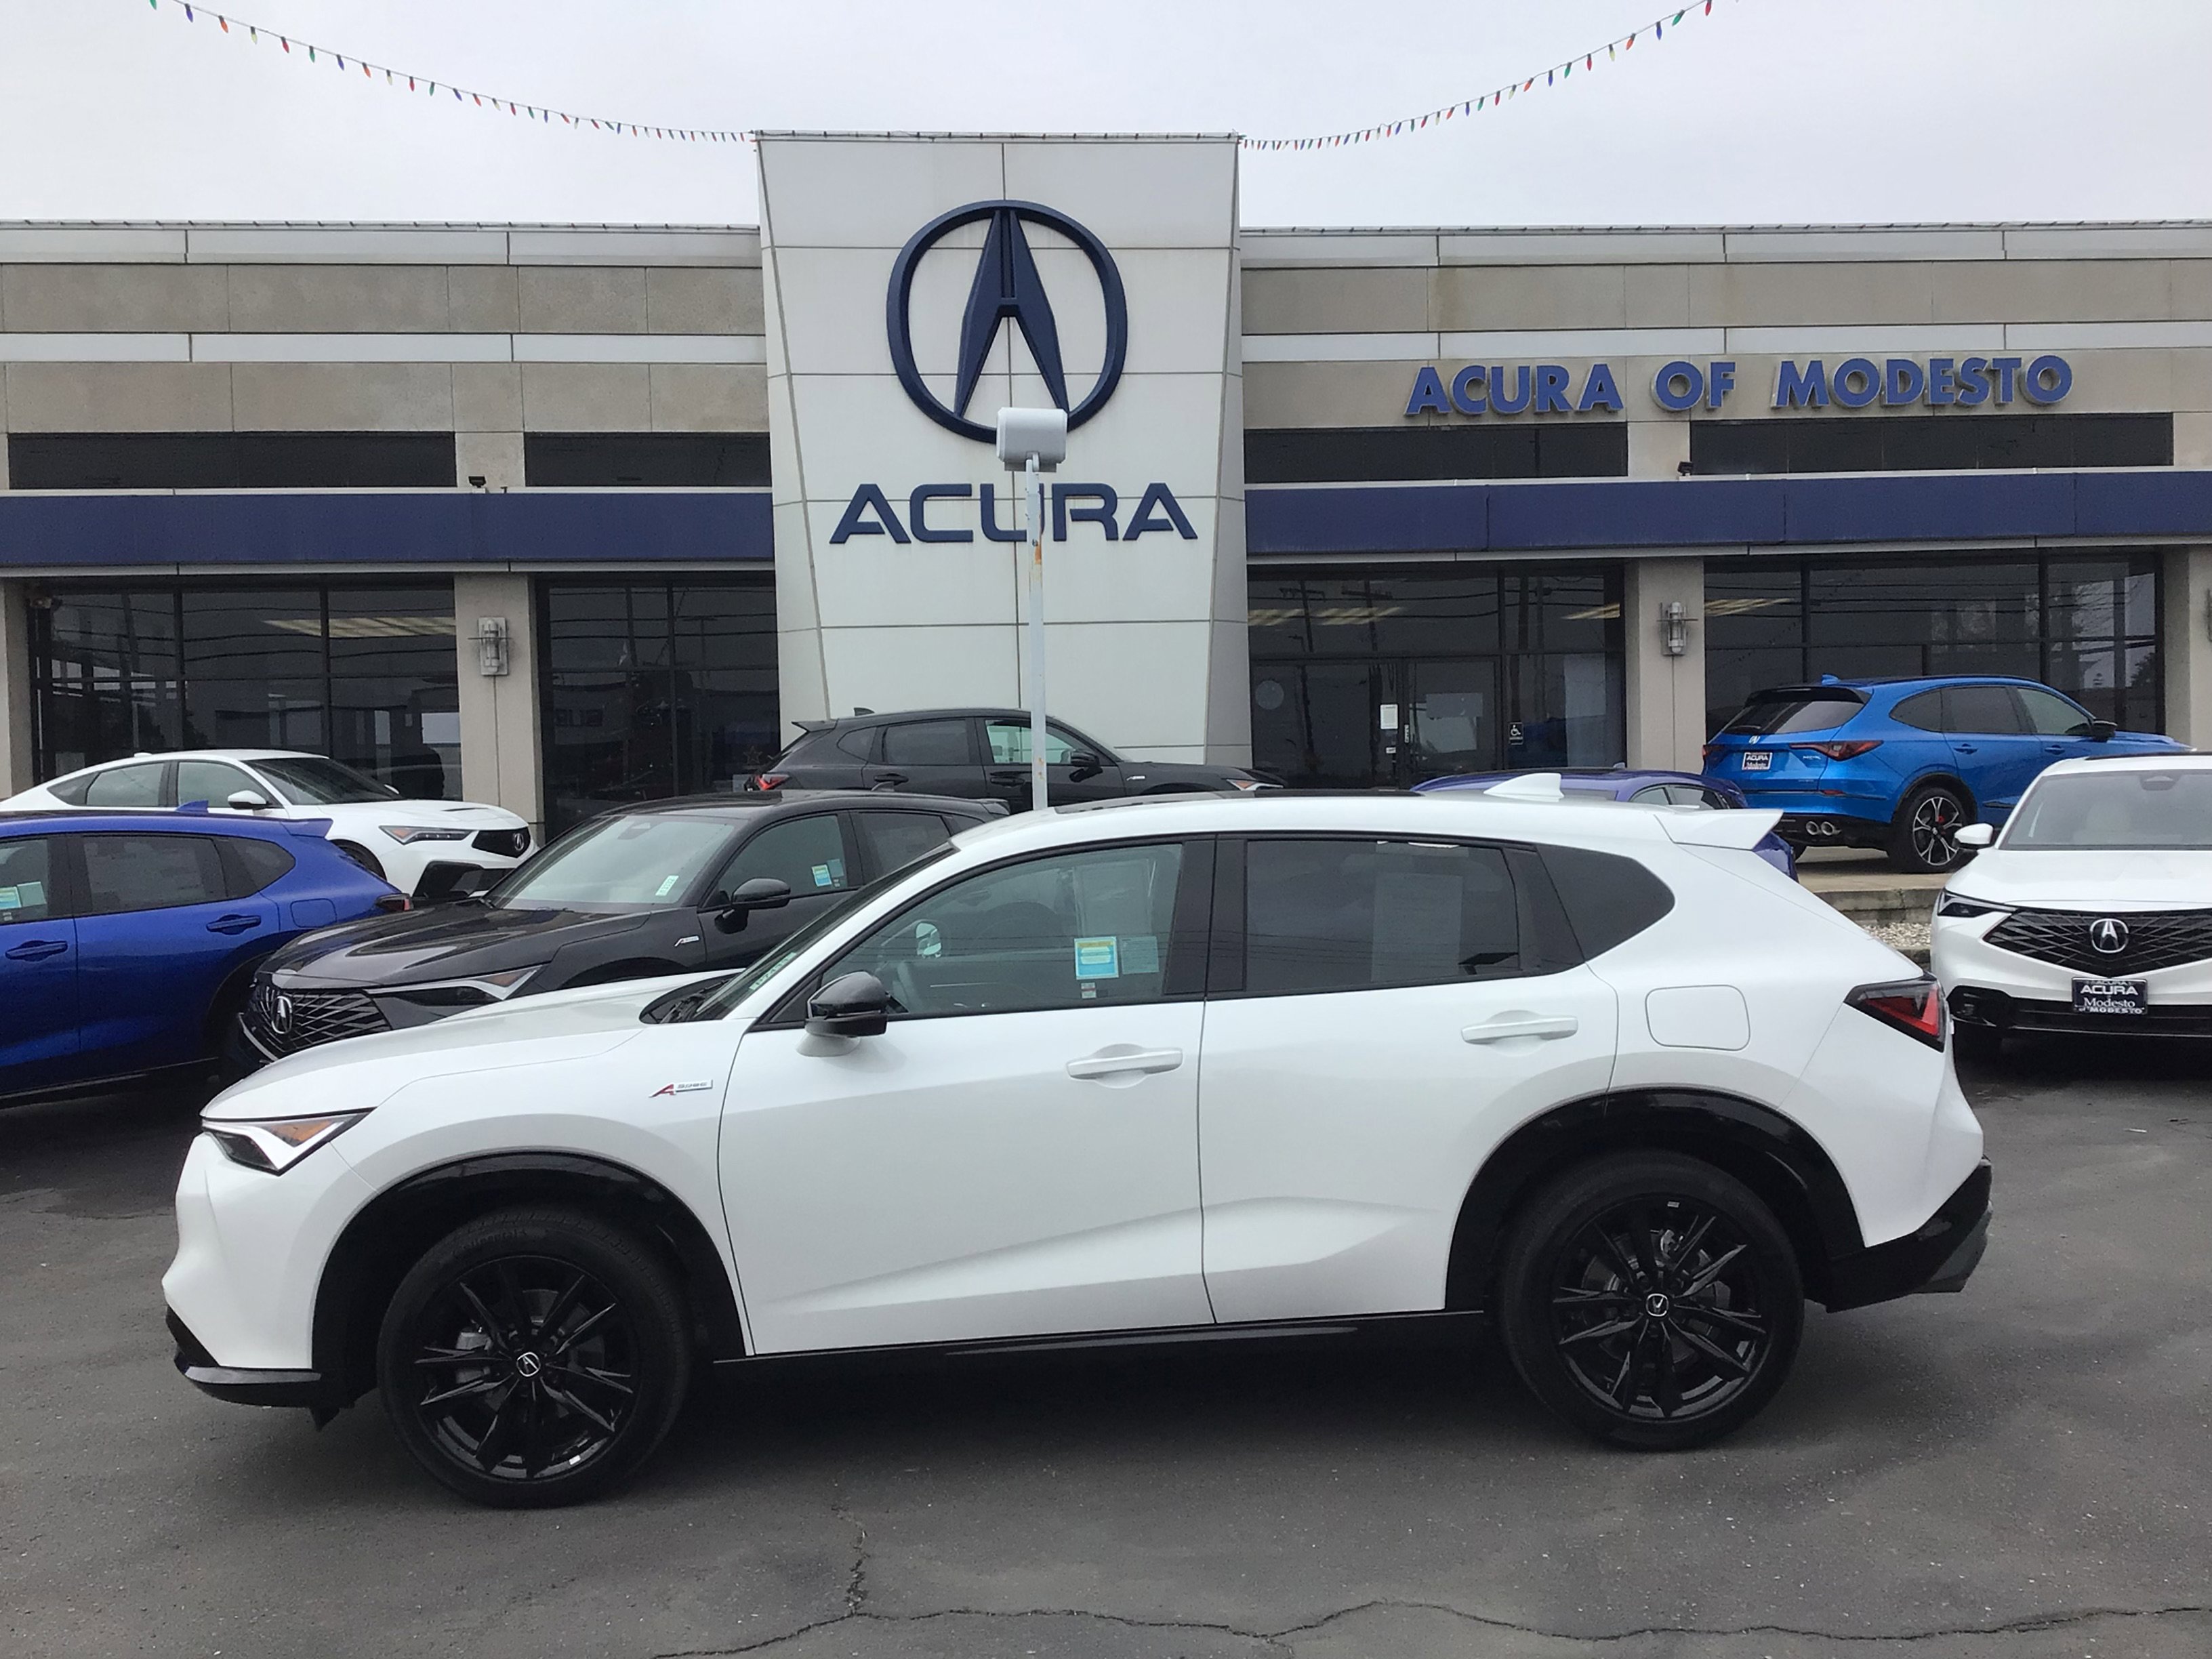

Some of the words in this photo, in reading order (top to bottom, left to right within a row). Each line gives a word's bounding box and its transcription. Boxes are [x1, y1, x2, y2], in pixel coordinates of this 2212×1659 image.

[1406, 362, 1624, 415] ACURA
[1652, 361, 1736, 411] OF
[1772, 354, 2072, 407] MODESTO
[829, 483, 1198, 544] ACURA
[2080, 985, 2139, 996] ACURA
[2083, 998, 2135, 1008] Modesto
